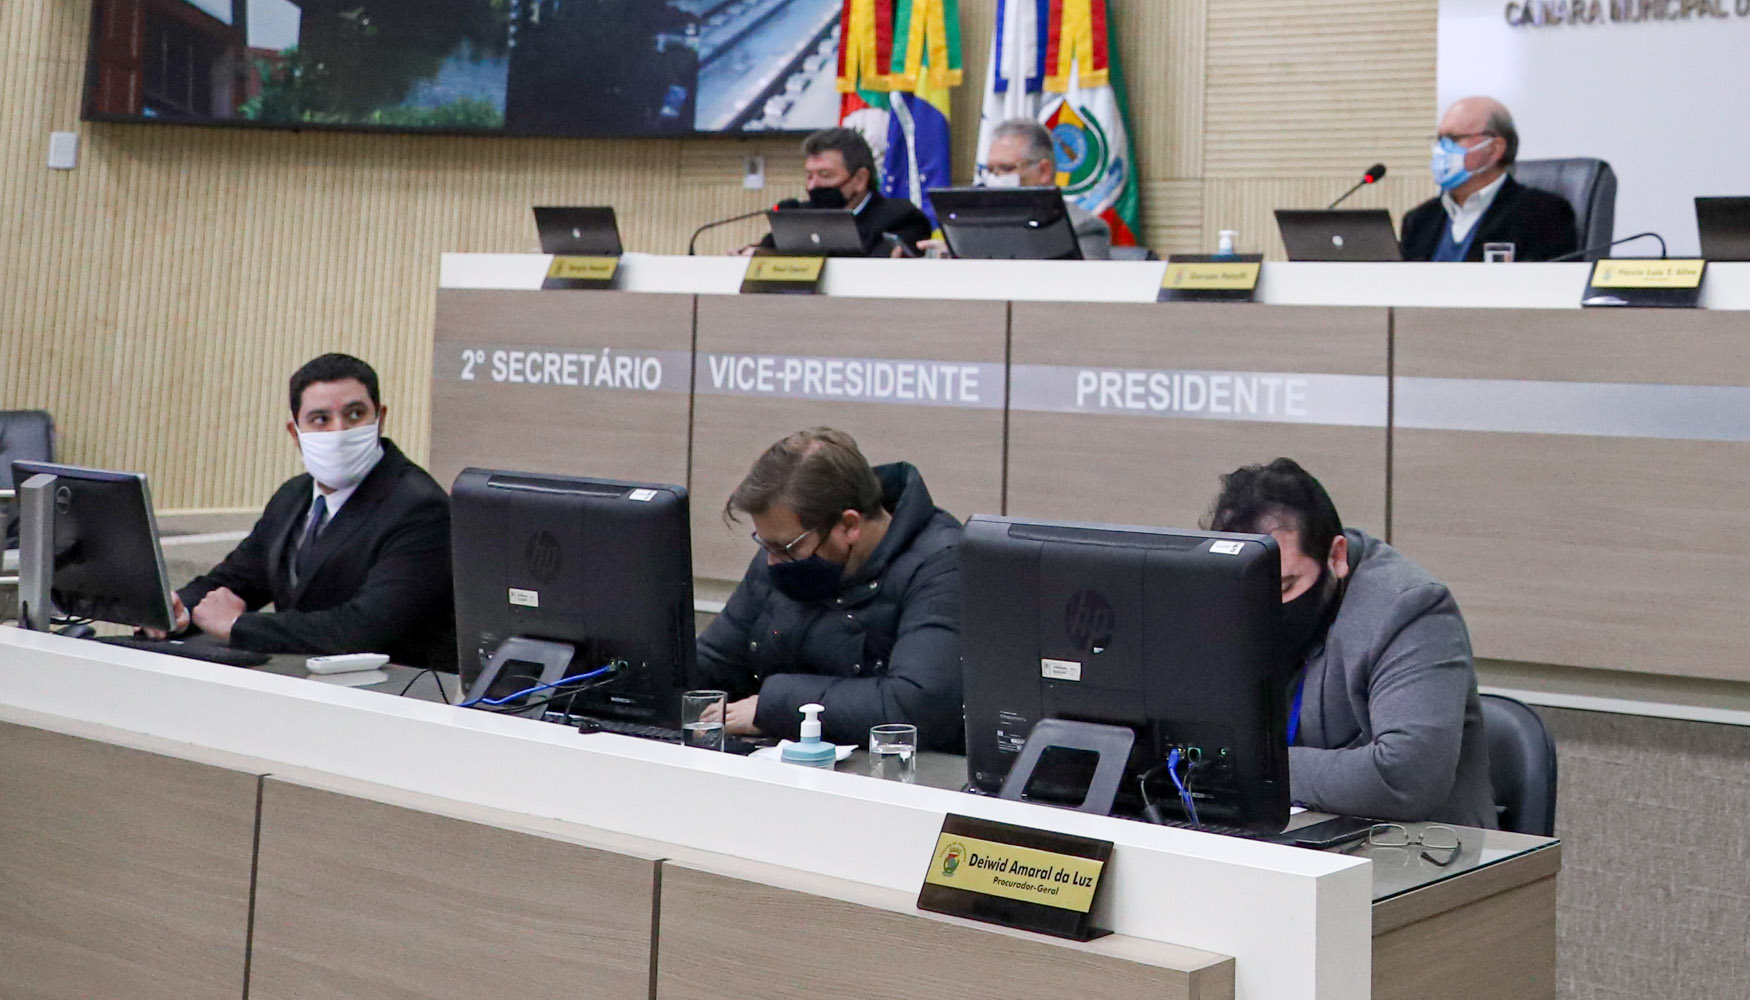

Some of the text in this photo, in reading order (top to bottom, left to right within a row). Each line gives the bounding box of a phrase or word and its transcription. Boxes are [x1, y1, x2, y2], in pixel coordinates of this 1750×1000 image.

[460, 348, 663, 391] 2º SECRETÁRIO
[708, 355, 980, 402] VICE-PRESIDENTE
[1076, 370, 1308, 416] PRESIDENTE
[968, 853, 1093, 888] Deiwid Amaral da Luz
[993, 875, 1060, 896] Procurador-Geral
